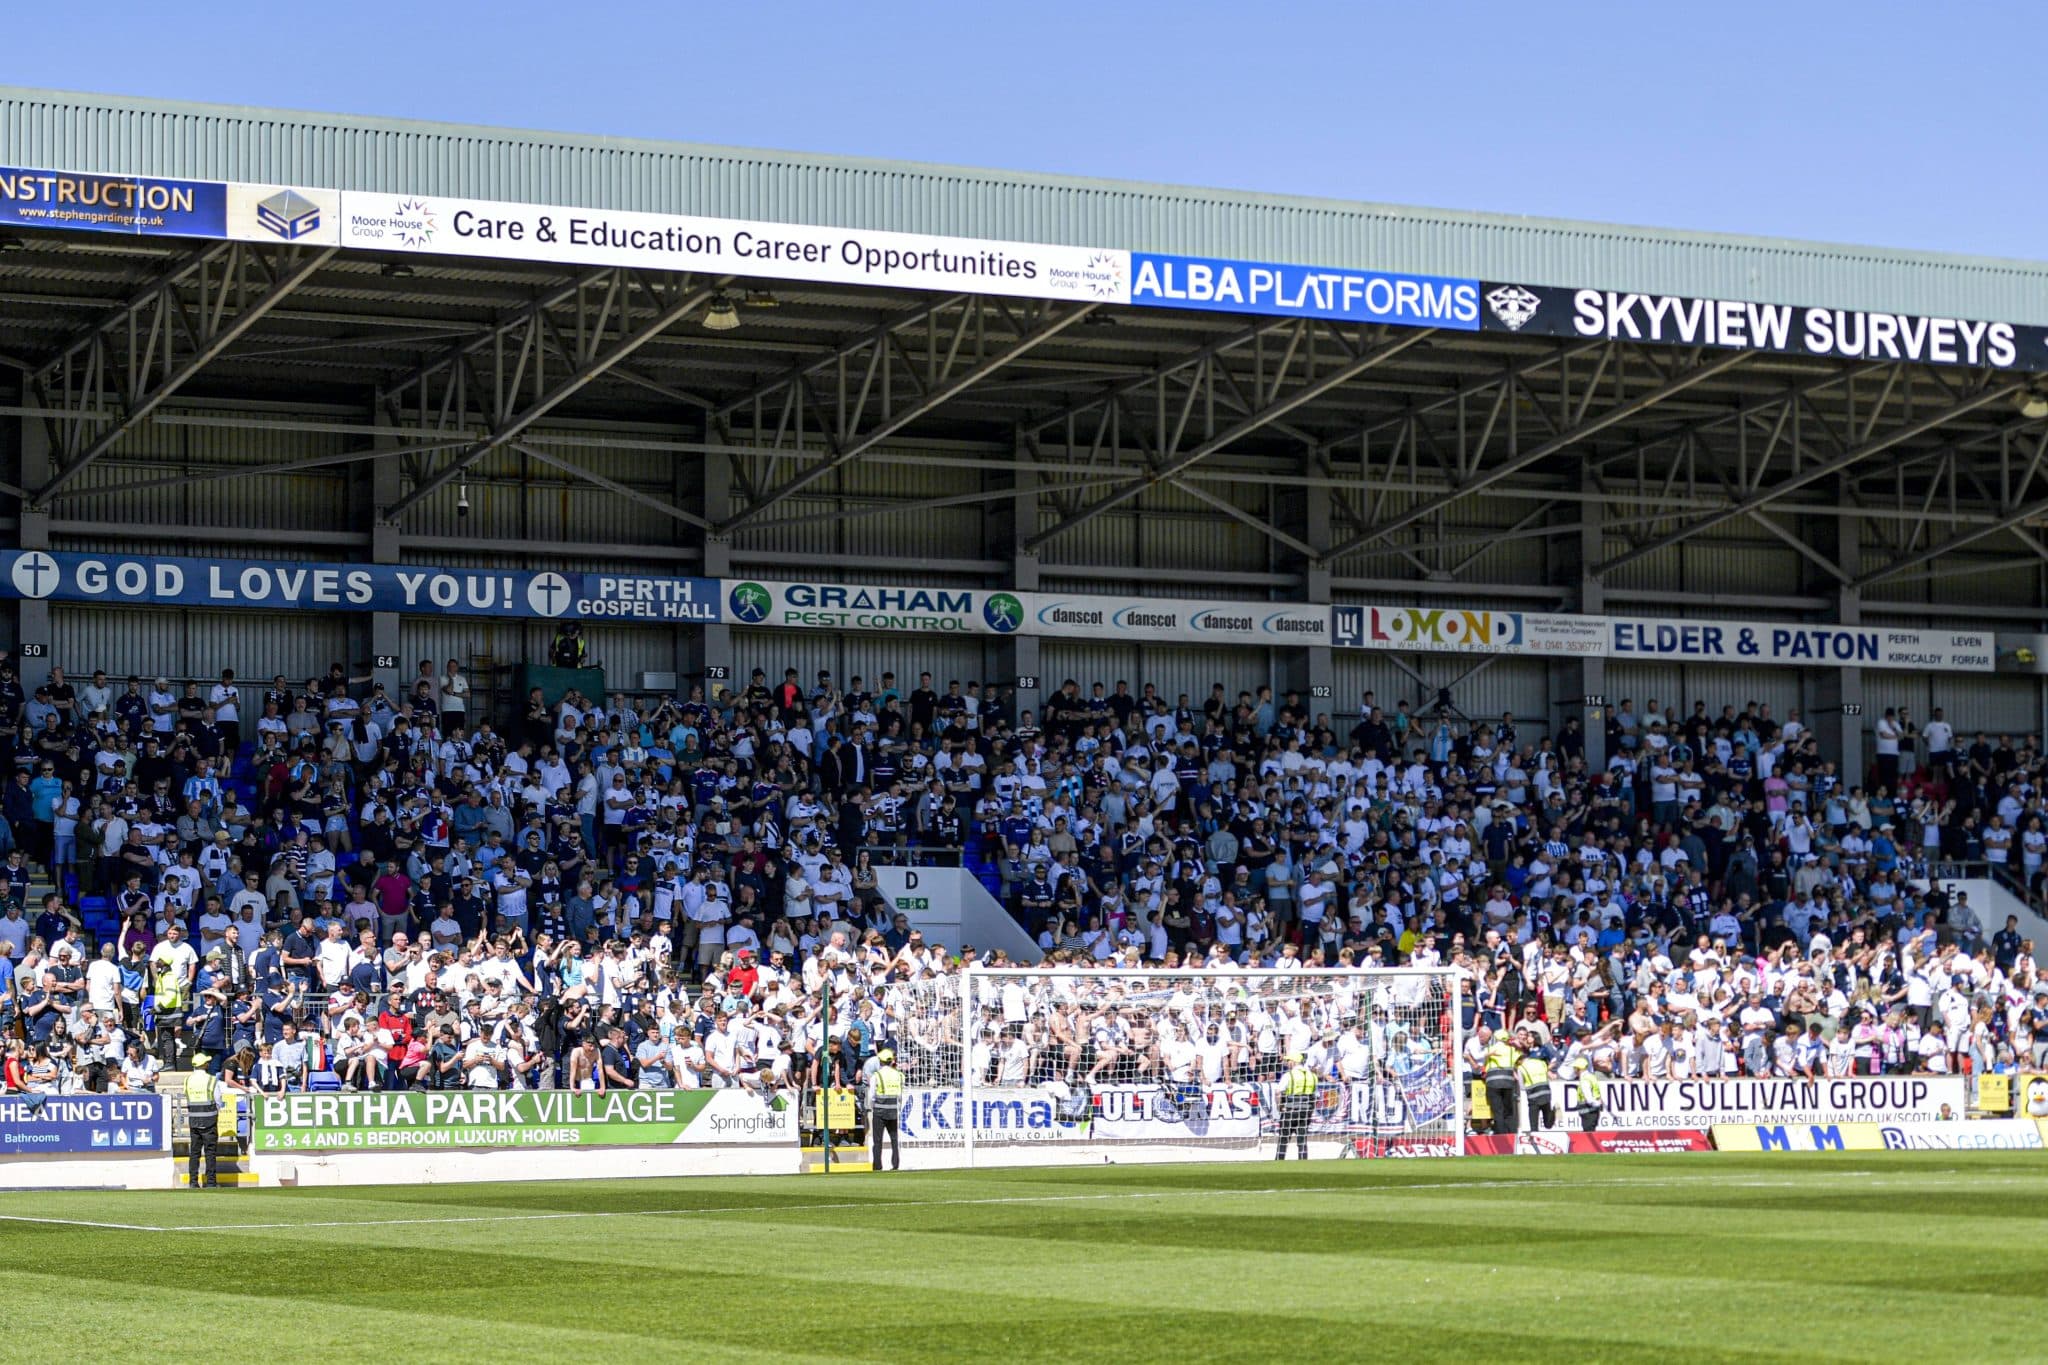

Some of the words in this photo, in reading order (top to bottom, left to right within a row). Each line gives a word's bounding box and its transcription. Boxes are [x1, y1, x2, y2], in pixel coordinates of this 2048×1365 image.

[0, 174, 193, 212] NSTRUCTION
[19, 207, 164, 226] www.stephengardiner.co.uk
[352, 216, 386, 227] Moore
[390, 218, 423, 230] House
[352, 227, 384, 239] Group
[453, 210, 524, 241] Care
[536, 216, 558, 243] &
[569, 218, 721, 256] Education
[733, 231, 831, 264] Career
[841, 240, 1037, 279] Opportunities
[1050, 268, 1079, 280] Moore
[1083, 270, 1112, 281] House
[1050, 277, 1078, 289] Group
[1133, 260, 1244, 303] ALBA
[1250, 268, 1478, 322] PLATFORMS
[1573, 289, 1792, 350] SKYVIEW
[1804, 308, 2017, 367] SURVEYS
[76, 560, 184, 597] GOD
[209, 565, 374, 605] LOVES
[396, 572, 513, 609] YOU!
[600, 578, 692, 602] PERTH
[784, 584, 972, 614] GRAHAM
[577, 599, 657, 617] GOSPEL
[663, 602, 716, 619] HALL
[1052, 608, 1103, 625] danscot
[784, 611, 851, 627] PEST
[856, 613, 972, 631] CONTROL
[1127, 611, 1177, 628] danscot
[1203, 614, 1253, 631] danscot
[1276, 617, 1324, 633] danscot
[1371, 607, 1523, 645] LOMOND
[1613, 622, 1725, 655] ELDER
[1736, 628, 1760, 657] &
[1773, 629, 1879, 661] PATON
[1888, 633, 1920, 645] PERTH
[1951, 635, 1982, 647] LEVEN
[24, 644, 41, 656] 50
[1888, 652, 1943, 665] KIRKCALDY
[377, 656, 393, 667] 64
[1951, 655, 1989, 666] FORFAR
[709, 667, 724, 679] 76
[1020, 677, 1034, 688] 89
[1312, 687, 1330, 697] 102
[1585, 696, 1603, 706] 114
[1843, 704, 1861, 715] 127
[906, 871, 919, 890] D
[1946, 883, 1956, 900] E
[1564, 1083, 1669, 1112] DNNY
[1679, 1082, 1819, 1111] SULLIVAN
[1830, 1080, 1928, 1109] GROUP
[0, 1101, 103, 1122] HEATING
[110, 1100, 153, 1121] LTD
[263, 1094, 415, 1127] BERTHA
[426, 1093, 524, 1125] PARK
[532, 1091, 676, 1123] VILLAGE
[922, 1091, 1076, 1130] Kima
[1101, 1090, 1251, 1123] ULTAS
[710, 1112, 786, 1134] Springfield
[1635, 1114, 1681, 1126] ACROSS
[5, 1133, 60, 1144] Bathrooms
[265, 1134, 279, 1148] 2,
[283, 1133, 297, 1147] 3,
[301, 1133, 311, 1146] 4
[315, 1132, 350, 1146] AND
[354, 1132, 363, 1145] 5
[367, 1130, 450, 1145] BEDROOM
[454, 1129, 518, 1144] LUXURY
[522, 1128, 581, 1143] HOMES
[1600, 1138, 1654, 1147] OFFICIAL
[1655, 1137, 1693, 1147] SPIRIT
